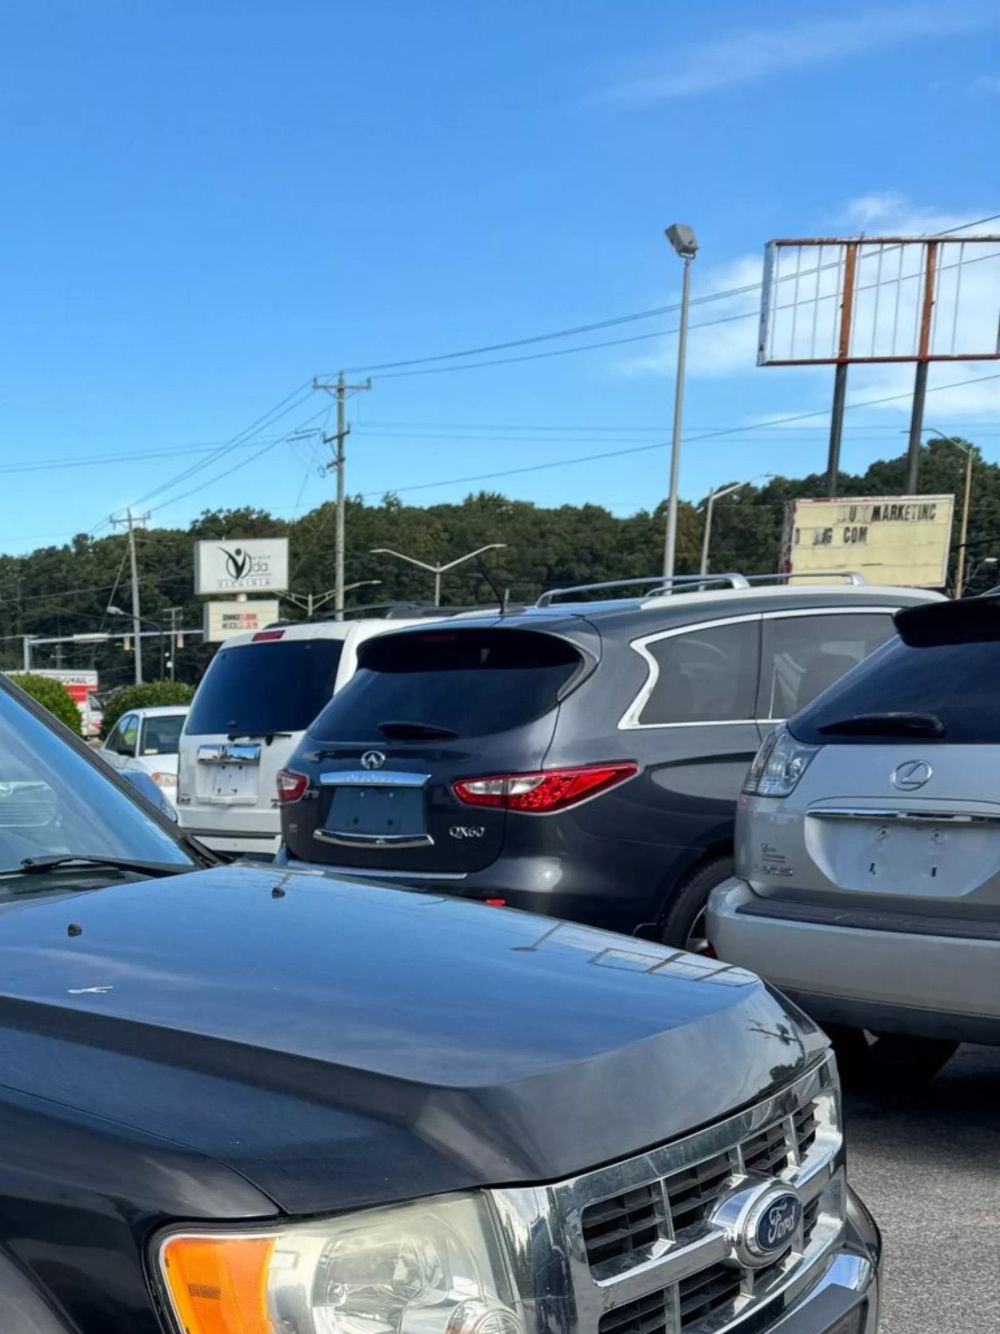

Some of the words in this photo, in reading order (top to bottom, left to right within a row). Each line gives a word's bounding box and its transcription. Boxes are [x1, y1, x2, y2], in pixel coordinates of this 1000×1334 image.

[843, 526, 869, 544] COM
[448, 825, 485, 840] QX60
[767, 1194, 796, 1244] Ford
